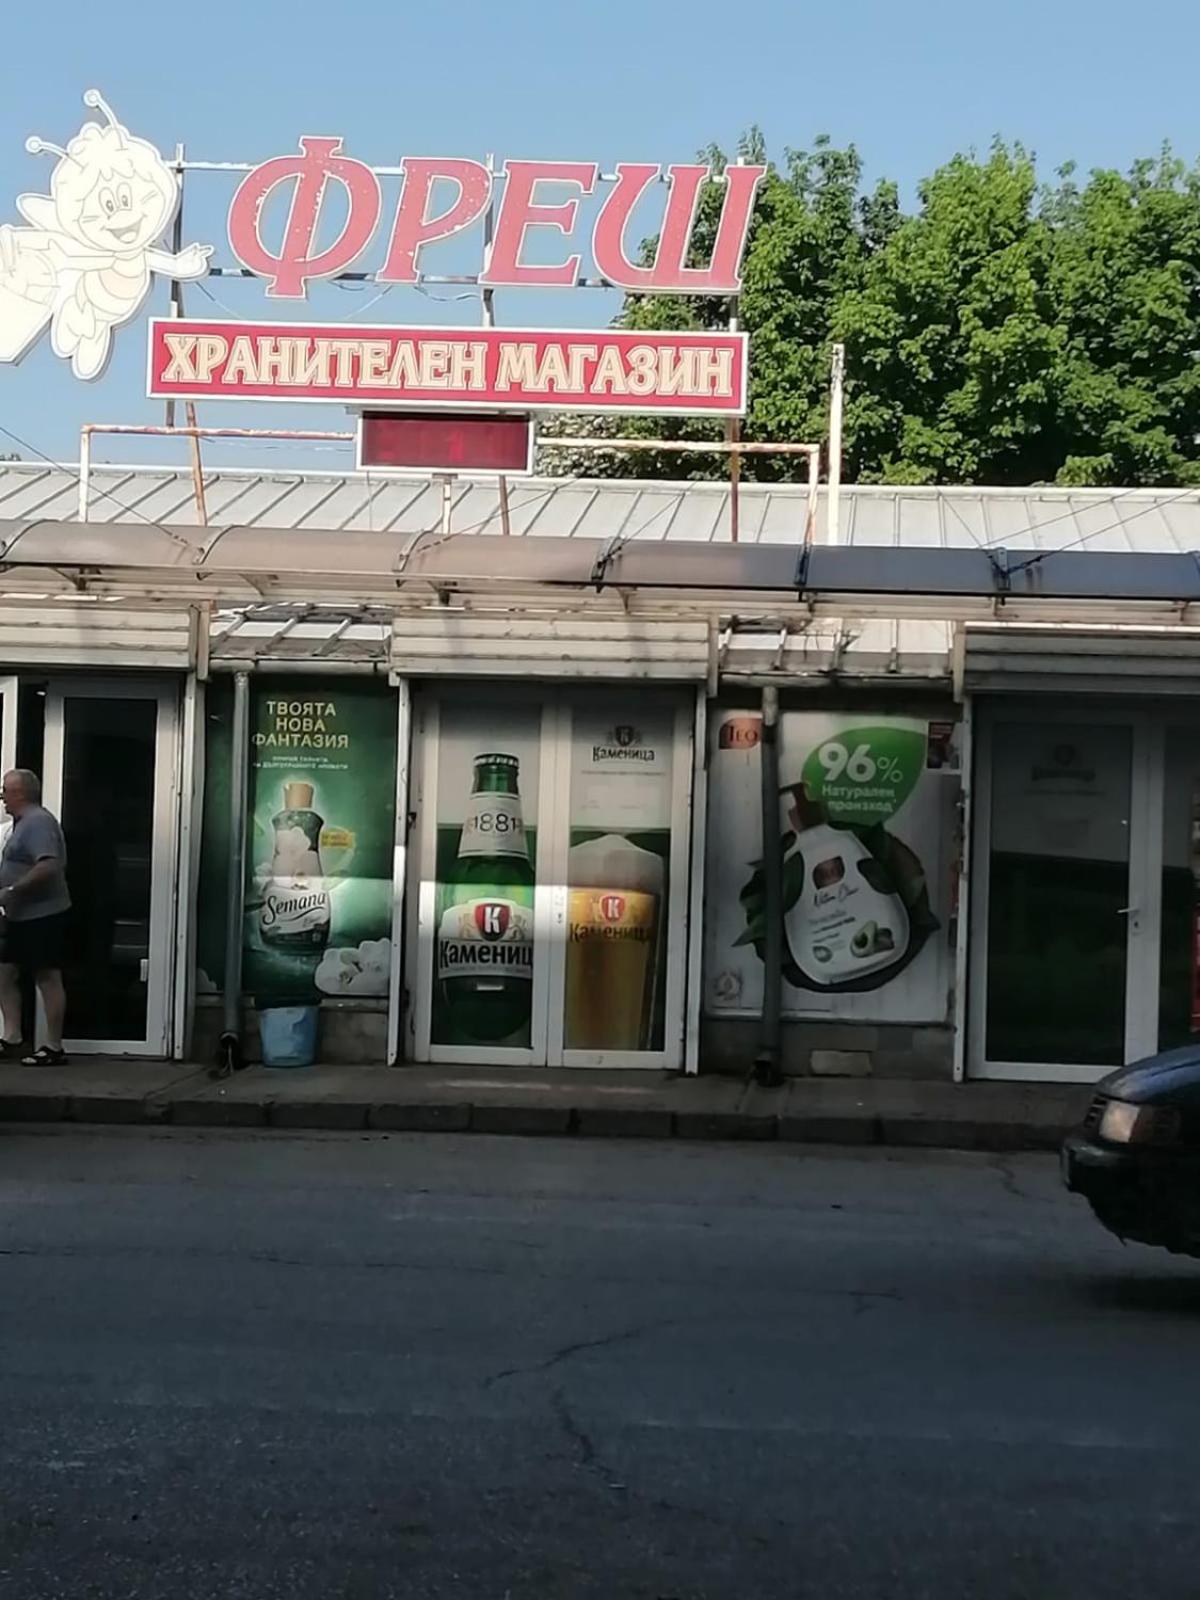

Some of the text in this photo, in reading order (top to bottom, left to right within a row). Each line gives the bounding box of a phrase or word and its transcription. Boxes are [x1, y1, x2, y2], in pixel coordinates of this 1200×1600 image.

[228, 135, 767, 298] ФРЕШ
[162, 334, 734, 397] ХРАНИТЕЛЕН МАГАЗИН
[266, 701, 336, 716] ТВОЯТА
[276, 717, 325, 732] НОВА
[251, 733, 349, 748] ФАНТАЗИЯ
[592, 746, 656, 762] Каменица
[822, 784, 895, 799] Натурален
[475, 813, 516, 832] 1881
[262, 892, 326, 925] Semana
